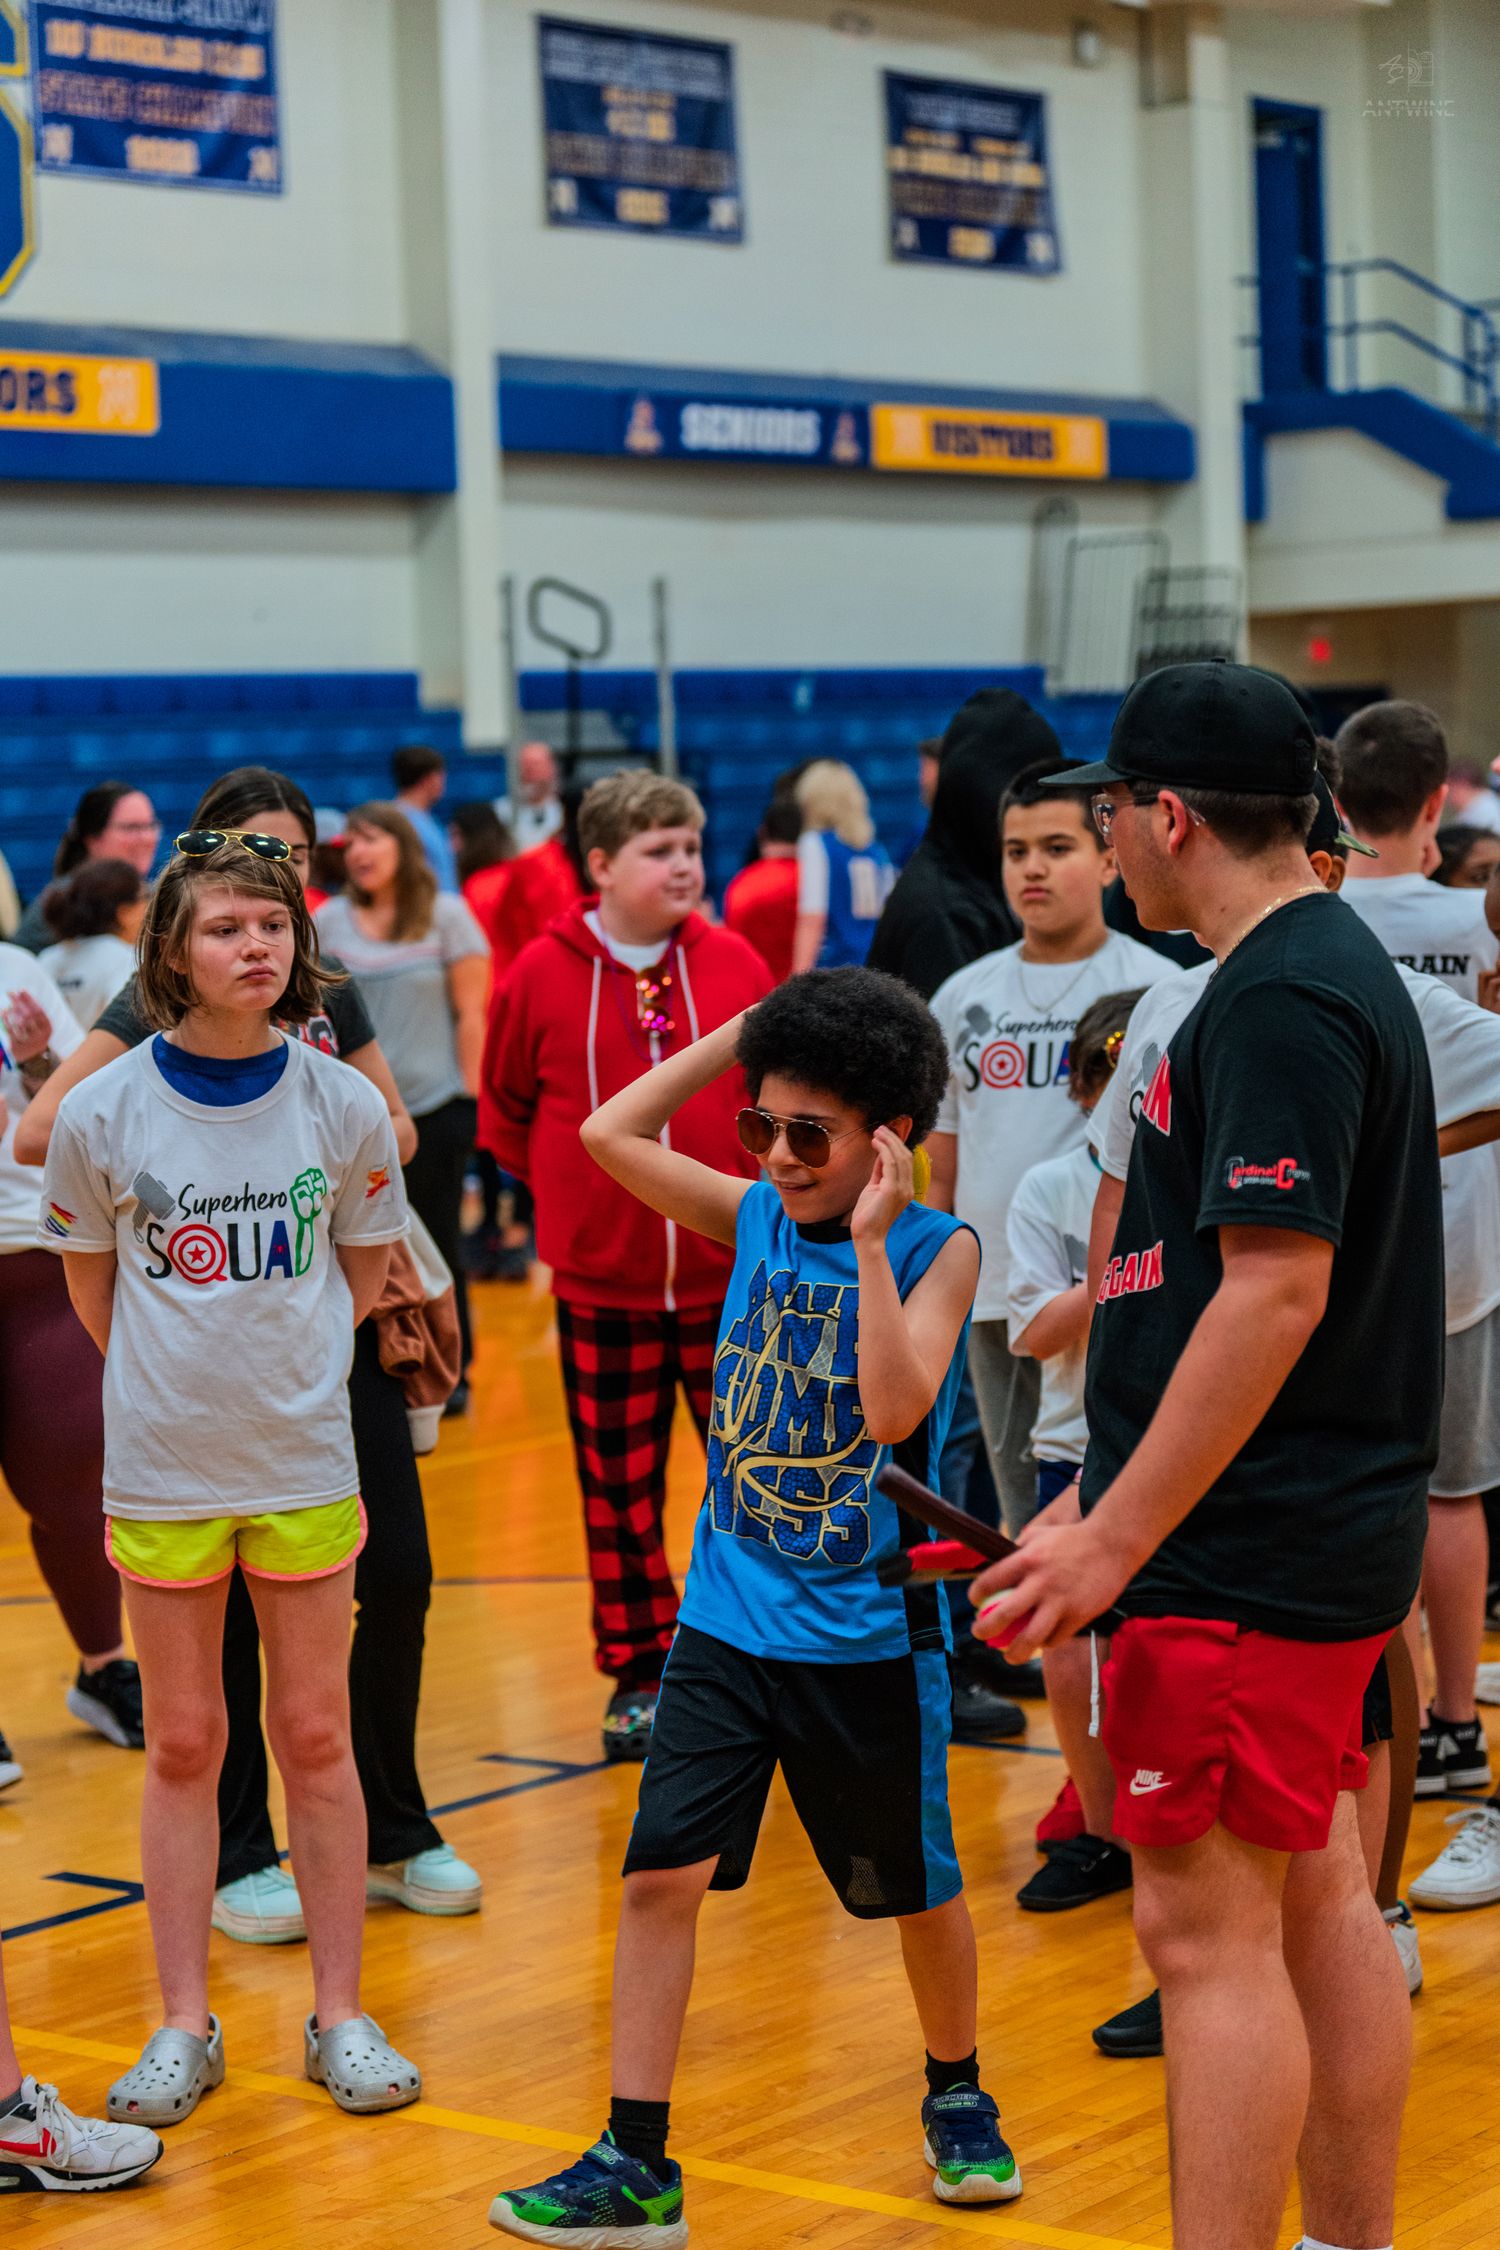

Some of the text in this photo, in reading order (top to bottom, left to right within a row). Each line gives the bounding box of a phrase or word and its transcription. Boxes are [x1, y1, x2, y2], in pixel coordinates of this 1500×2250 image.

[1392, 954, 1470, 975] RAIN
[965, 1040, 1071, 1093] SQUA
[176, 1182, 288, 1224] Superhero
[1134, 1769, 1164, 1785] NIKE
